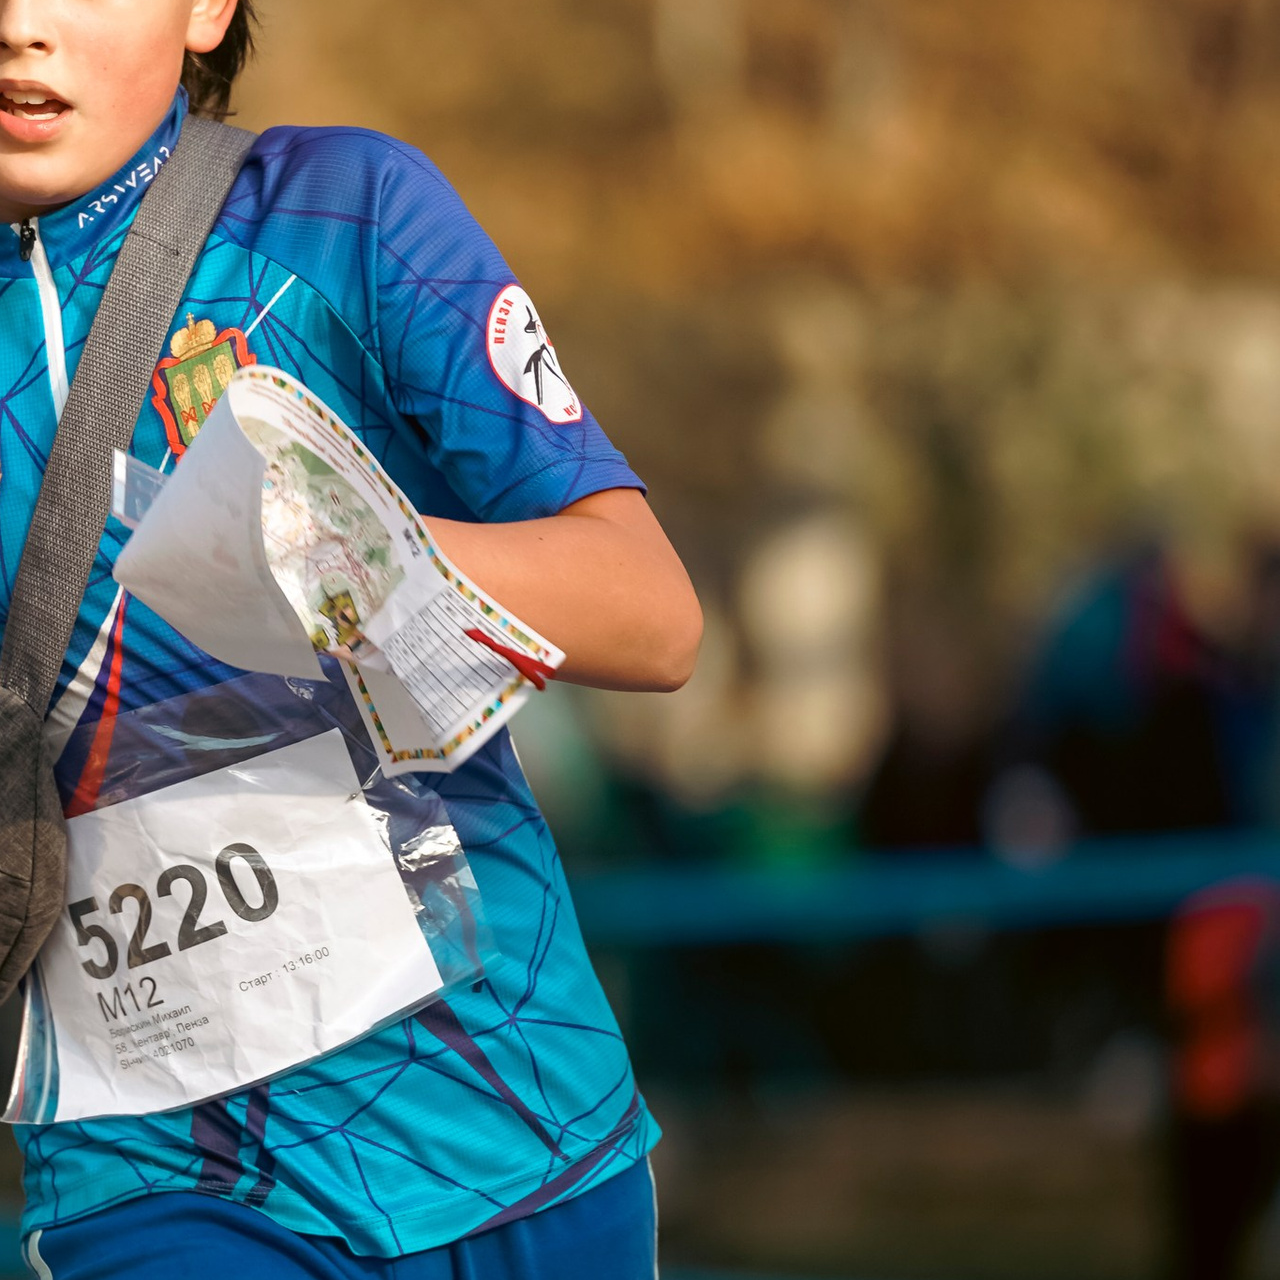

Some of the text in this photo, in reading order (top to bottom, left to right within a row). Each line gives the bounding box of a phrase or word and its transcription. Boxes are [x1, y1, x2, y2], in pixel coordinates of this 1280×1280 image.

[67, 842, 279, 980] 5220
[239, 972, 273, 992] Старт
[282, 946, 330, 973] 13:16:00
[151, 1005, 192, 1026] Михаил
[175, 1016, 210, 1034] Пенза
